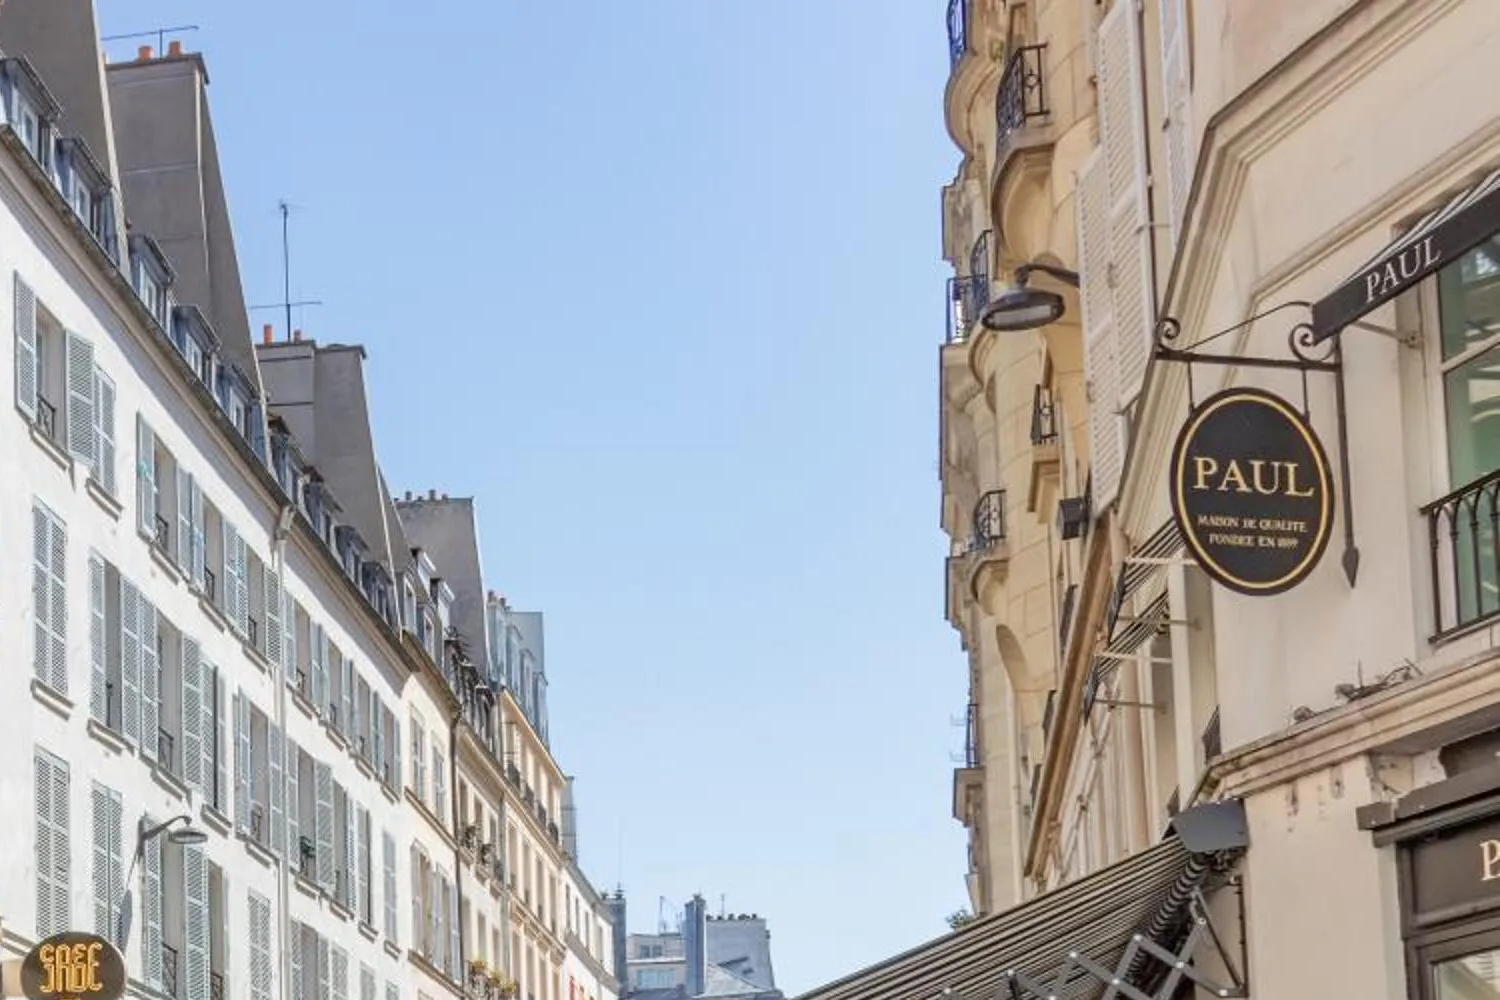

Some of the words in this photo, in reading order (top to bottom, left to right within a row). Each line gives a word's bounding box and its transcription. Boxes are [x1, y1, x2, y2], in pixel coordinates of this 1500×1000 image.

[1366, 236, 1442, 303] PAUL
[1192, 455, 1316, 497] PAUL
[1242, 518, 1257, 529] DE
